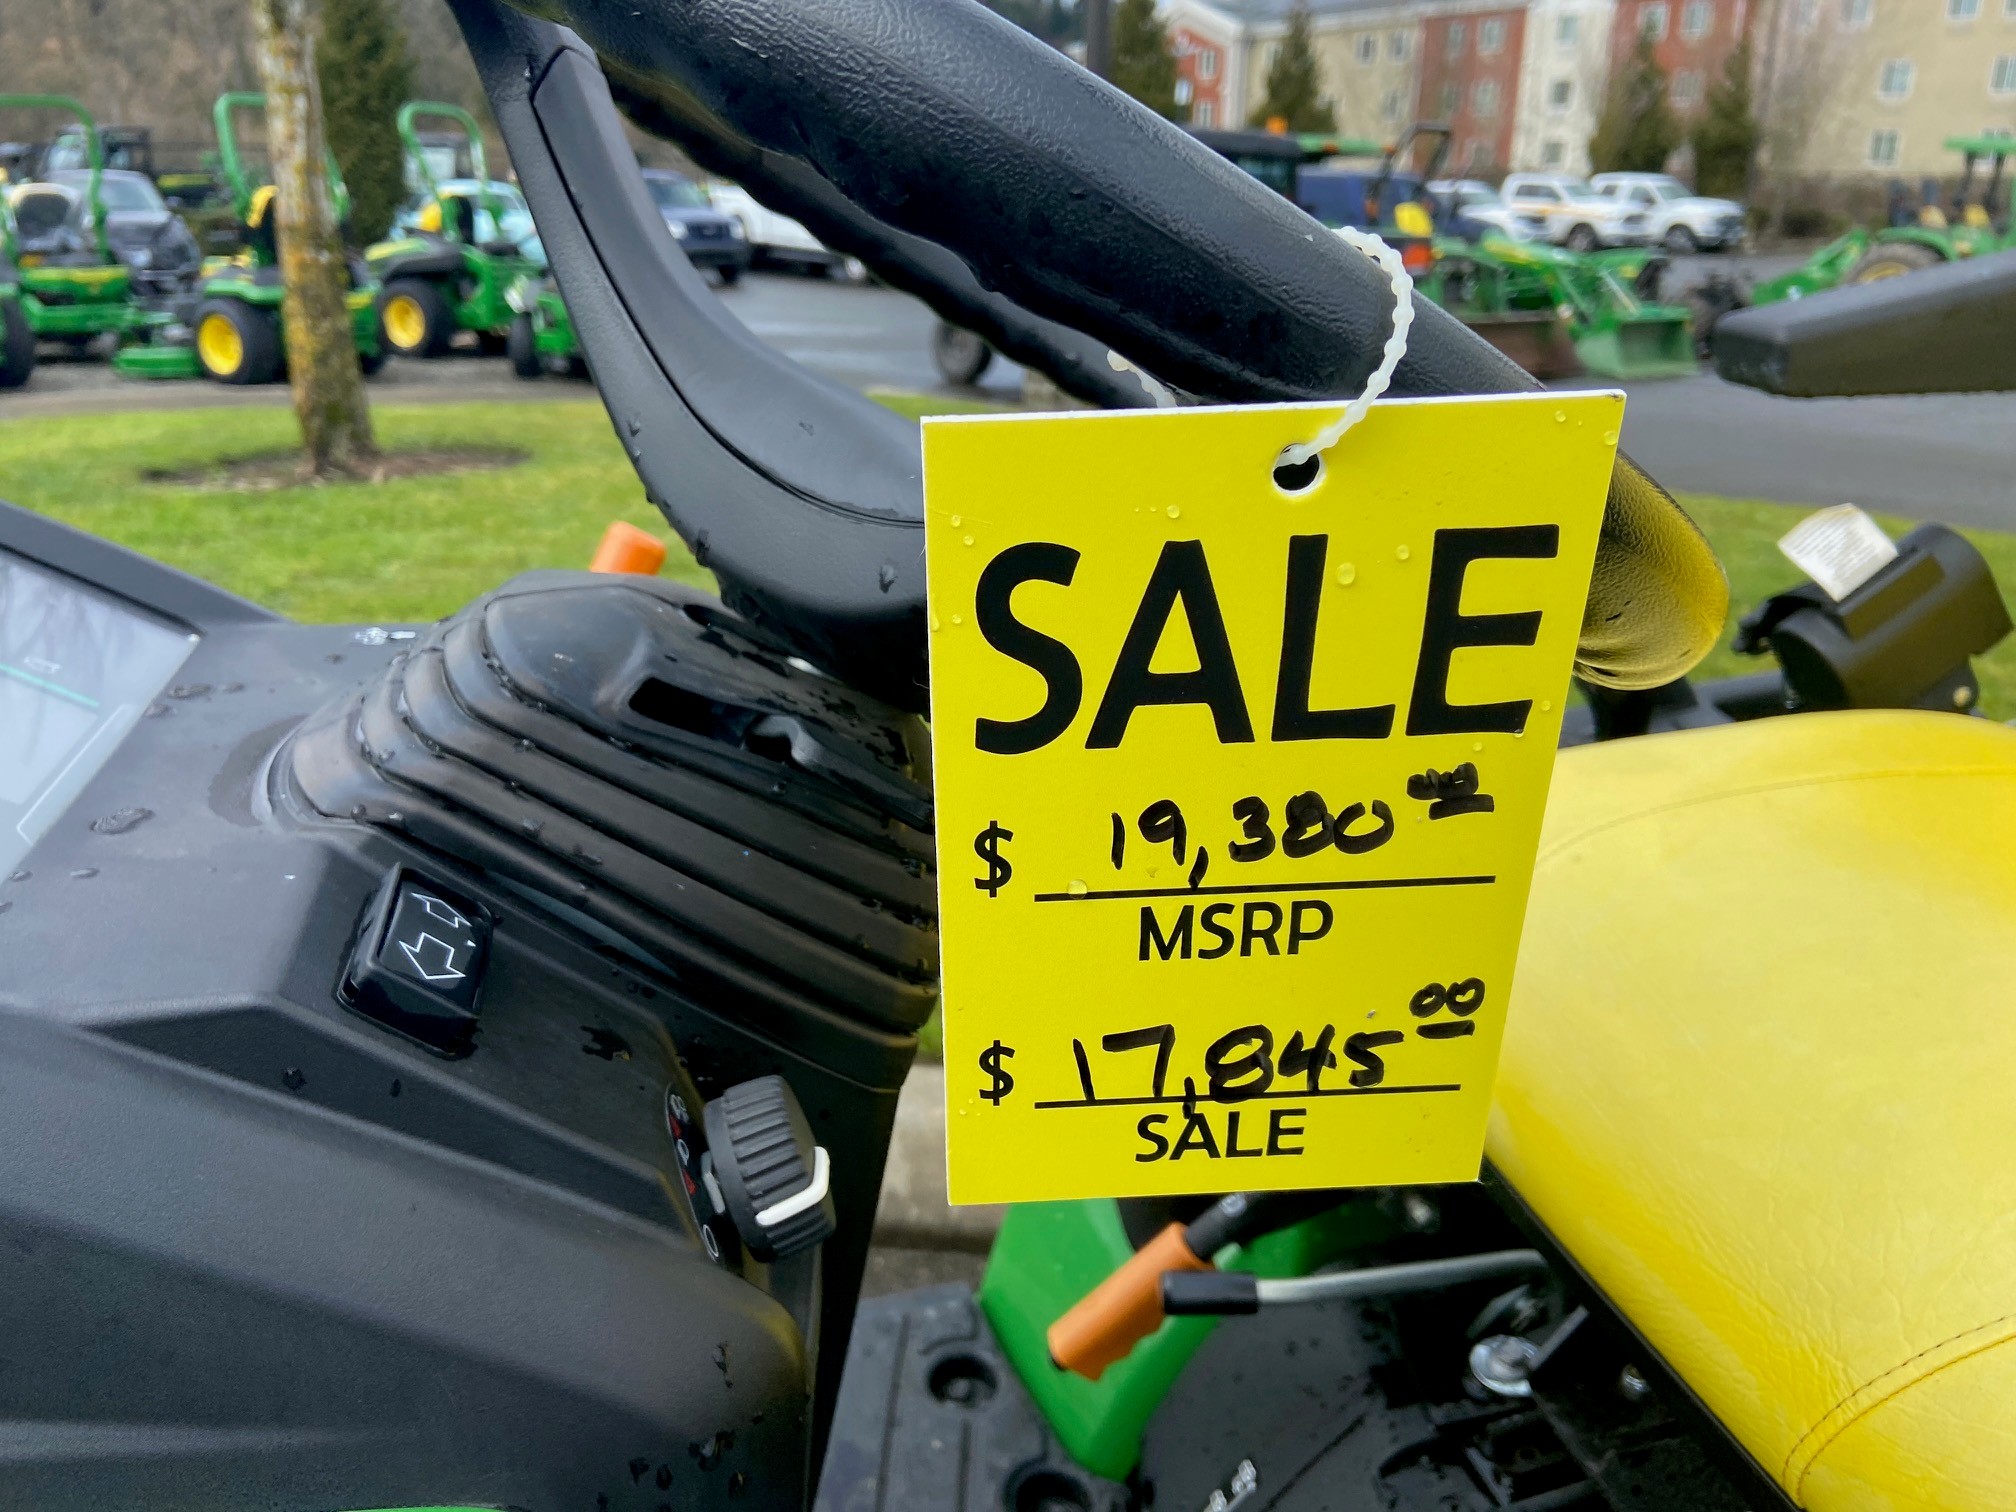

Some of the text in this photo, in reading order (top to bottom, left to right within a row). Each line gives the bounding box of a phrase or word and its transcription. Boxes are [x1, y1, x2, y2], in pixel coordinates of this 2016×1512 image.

[974, 523, 1560, 757] SALE
[973, 820, 1014, 898] $
[1138, 898, 1335, 961] MSRP
[978, 1039, 1016, 1107] $
[1135, 1108, 1307, 1163] SALE
